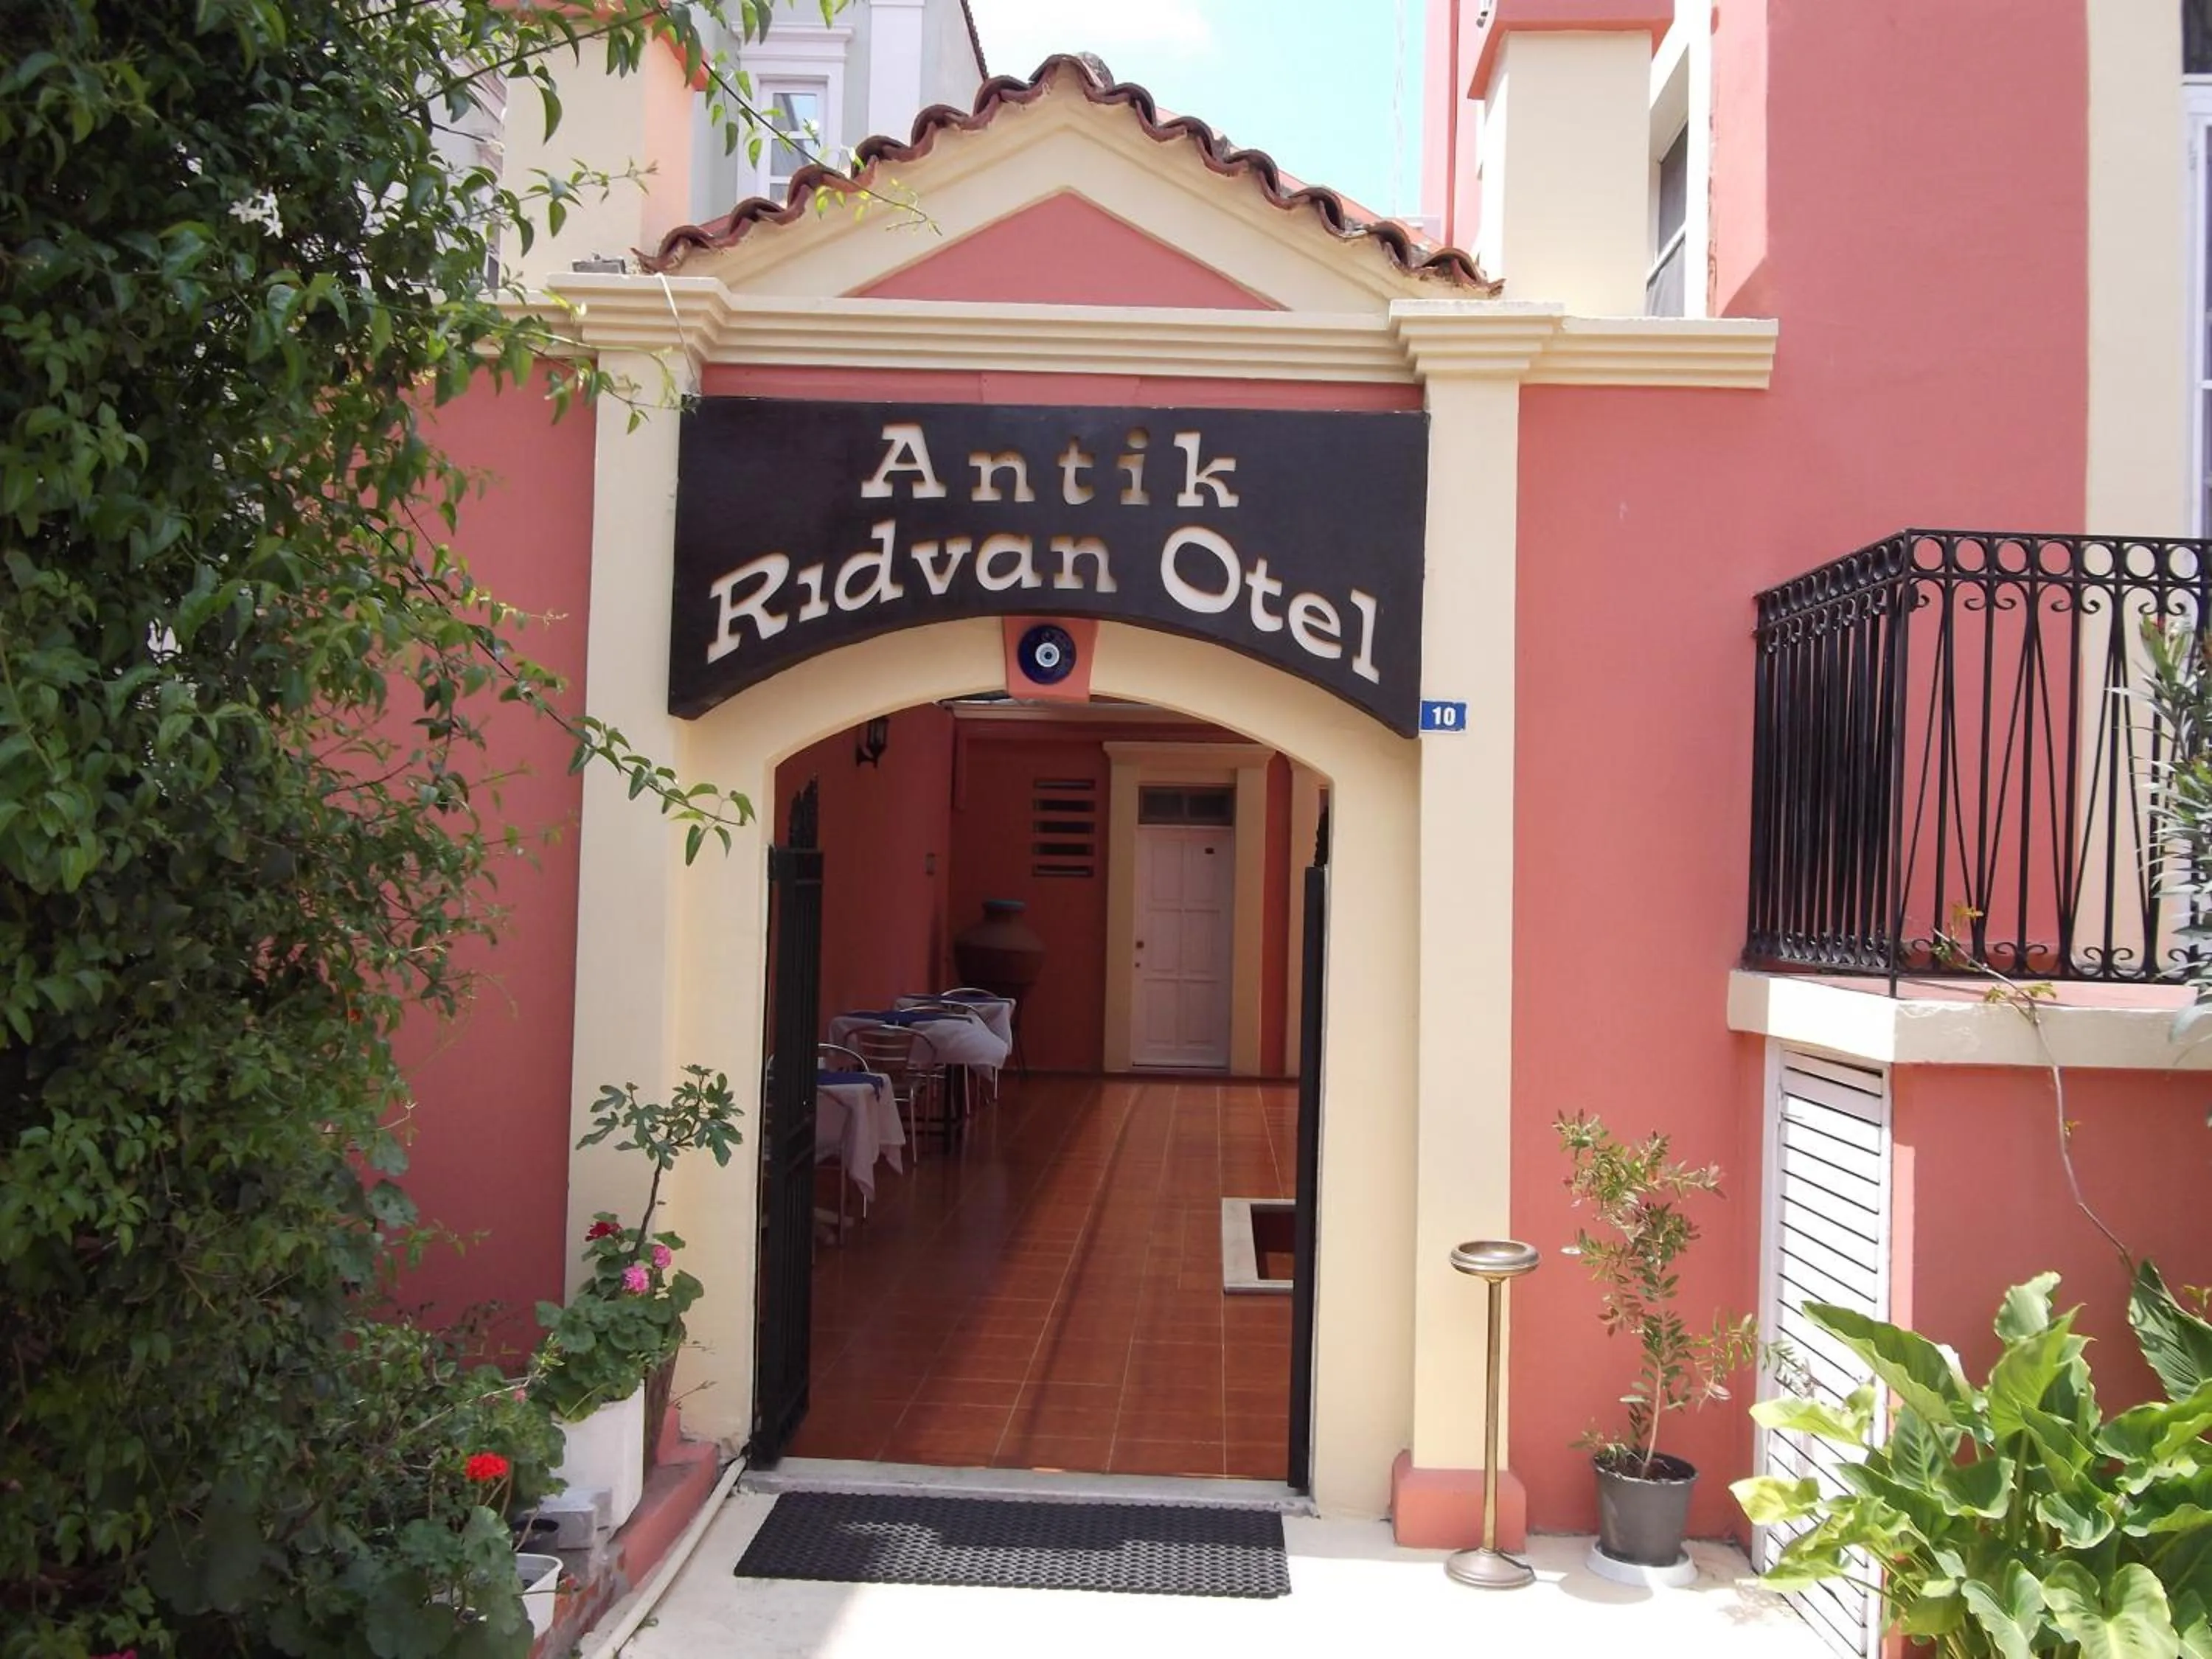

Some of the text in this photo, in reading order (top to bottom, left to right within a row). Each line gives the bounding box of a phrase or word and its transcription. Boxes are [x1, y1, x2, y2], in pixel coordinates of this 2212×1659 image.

[860, 423, 1239, 508] Antik
[1160, 526, 1380, 685] Otel
[1432, 706, 1456, 726] 10
